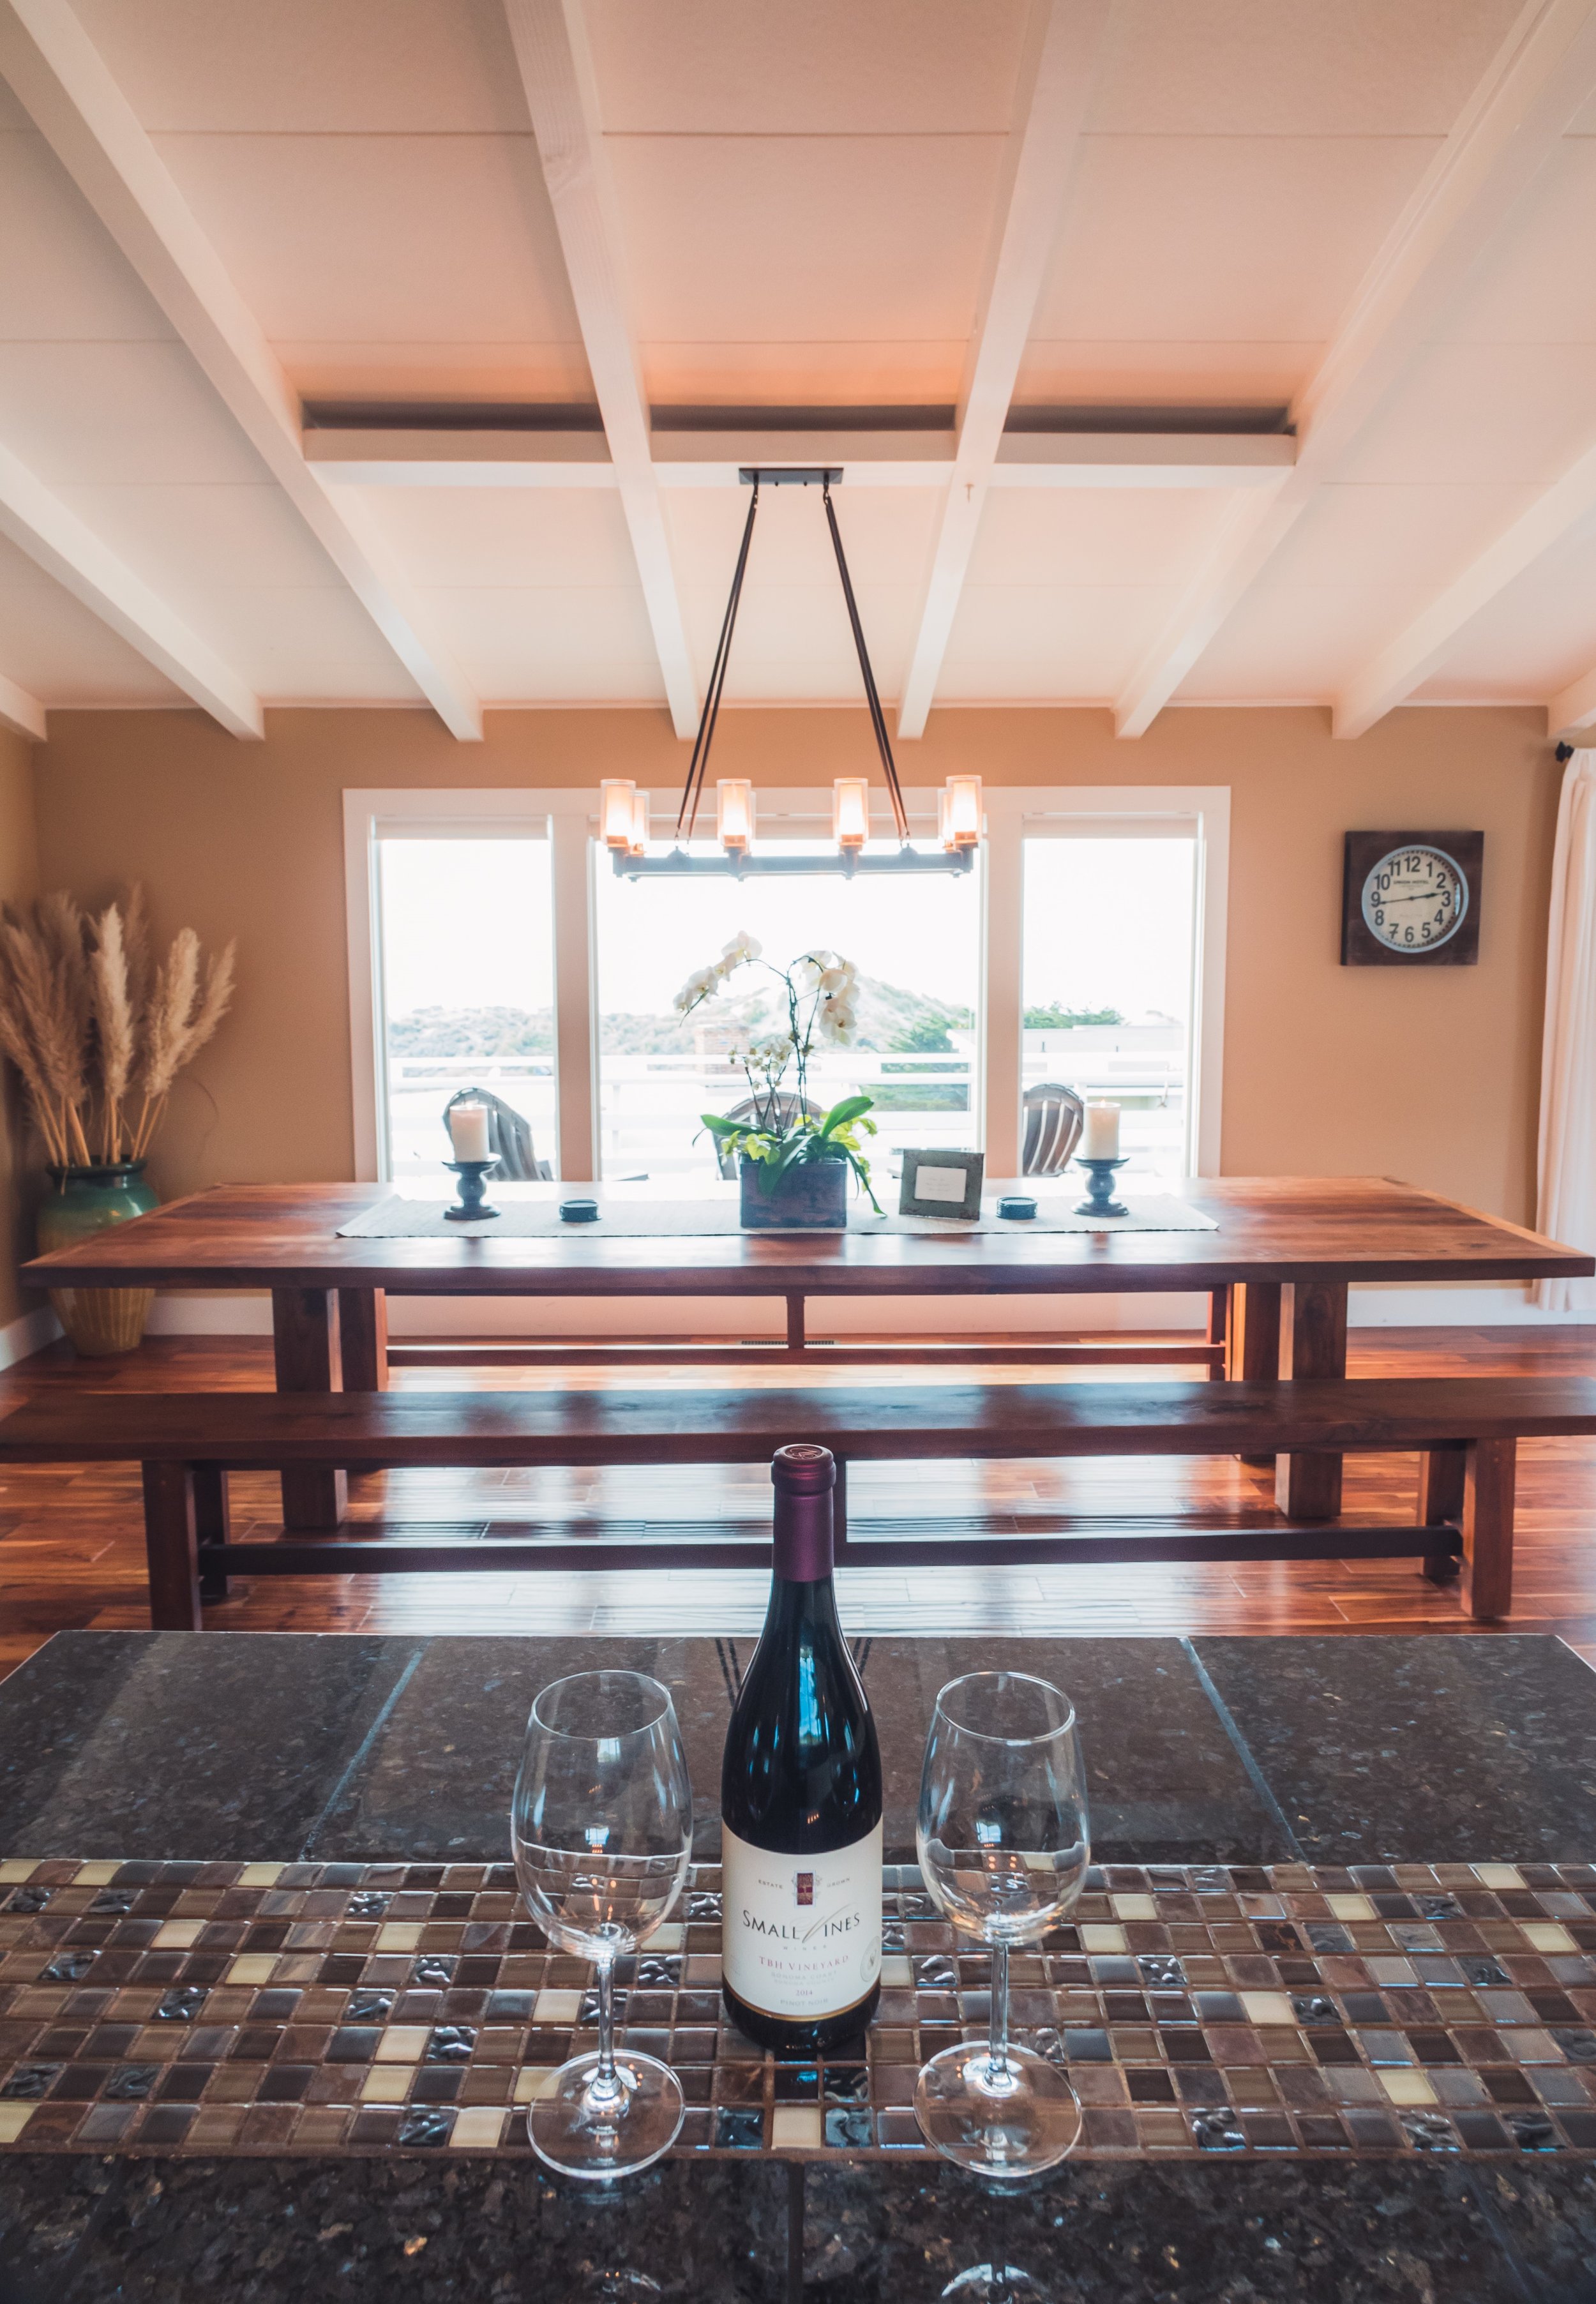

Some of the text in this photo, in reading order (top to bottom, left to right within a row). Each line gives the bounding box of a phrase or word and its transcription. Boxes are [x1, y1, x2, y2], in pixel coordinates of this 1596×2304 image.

[1388, 860, 1401, 877] 11
[1404, 855, 1421, 873] 12
[1426, 861, 1433, 878] 1
[1374, 873, 1390, 890] 10
[1436, 872, 1446, 889] 2
[1371, 891, 1381, 908] 9
[1441, 890, 1451, 907] 3
[1374, 910, 1384, 926] 8
[1434, 909, 1443, 925] 4
[1389, 923, 1399, 940] 7
[1404, 926, 1414, 943] 6
[1421, 922, 1431, 938] 5
[757, 1878, 850, 1889] ESTATE GROWN
[742, 1909, 800, 1940] SMALL
[759, 1955, 783, 1970] TBH
[788, 1955, 849, 1971] VINEYARD
[771, 1971, 806, 1980] SONOMA
[780, 1998, 829, 2007] PINOT NOIR
